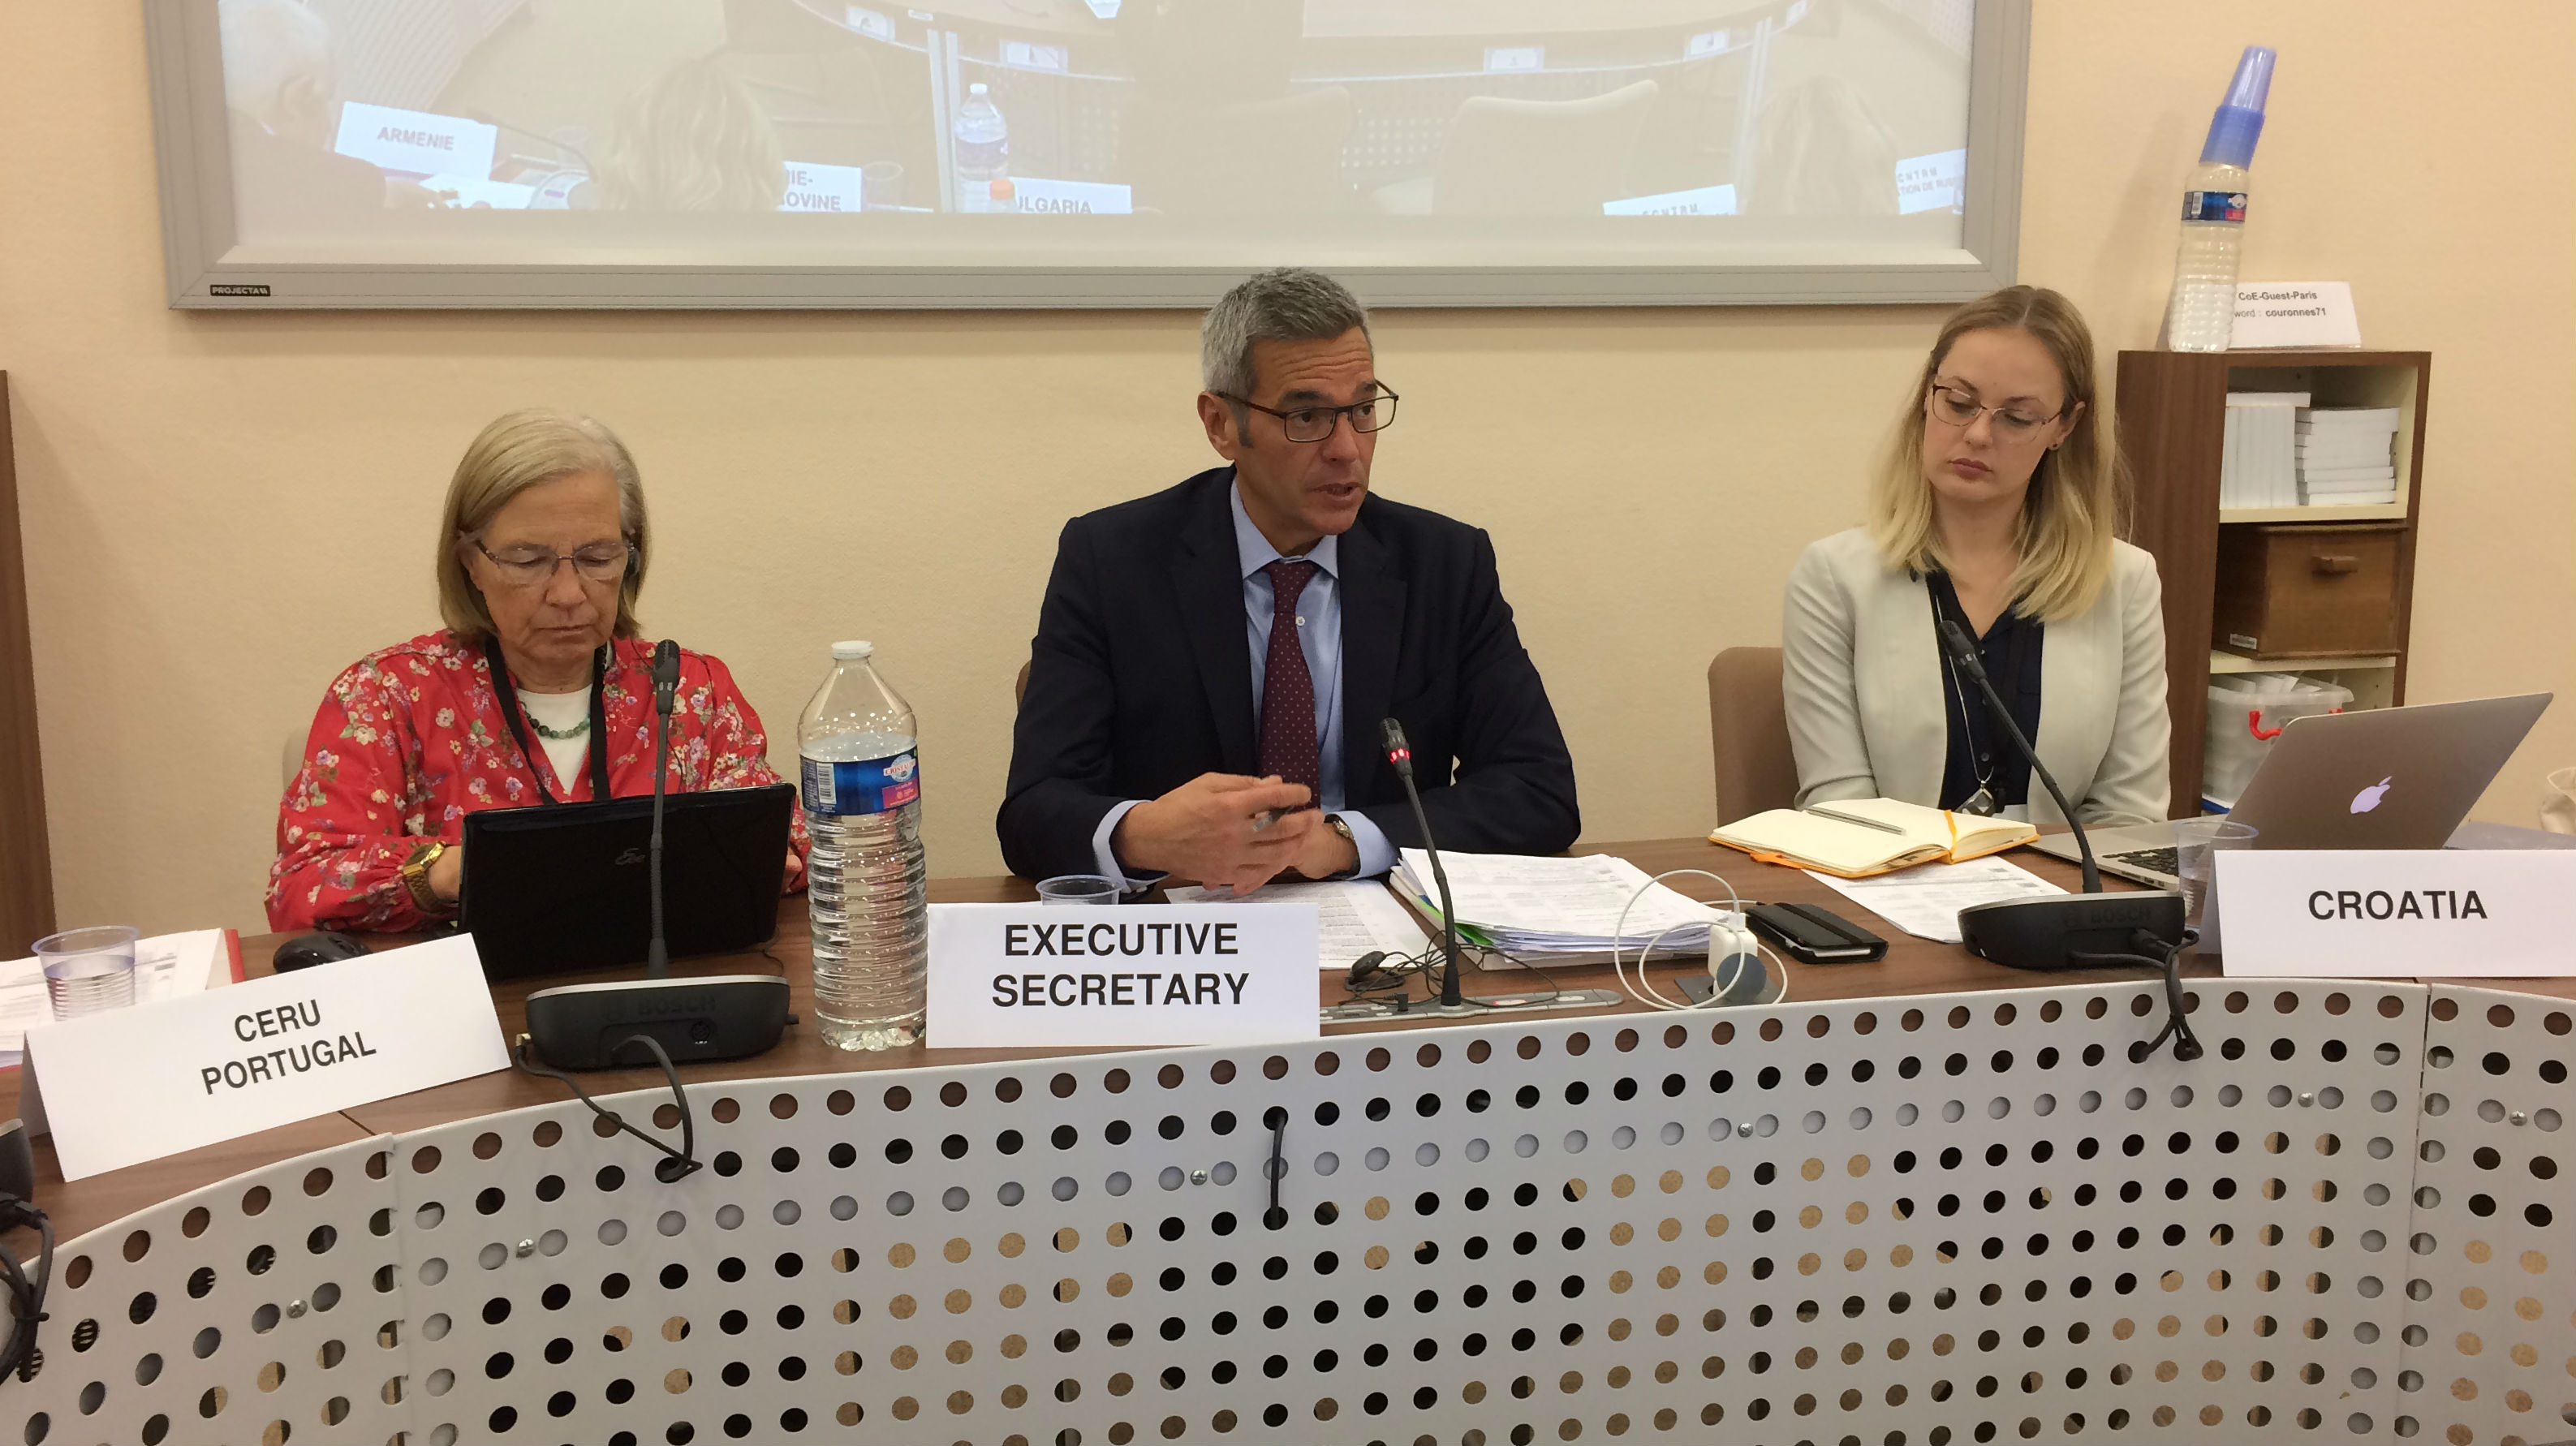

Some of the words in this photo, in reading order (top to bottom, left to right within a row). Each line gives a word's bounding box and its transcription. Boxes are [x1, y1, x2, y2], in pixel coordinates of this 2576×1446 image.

[377, 127, 454, 150] ARMENIE
[782, 192, 842, 213] OVINE
[2238, 290, 2318, 301] CoE-Guest-Paris
[2265, 307, 2326, 317] couronnes71
[2091, 906, 2151, 924] BOSCH
[2308, 890, 2488, 920] CROATIA
[1005, 923, 1238, 957] EXECUTIVE
[992, 972, 1250, 1008] SECRETARY
[235, 999, 321, 1042] CERU
[201, 1031, 377, 1095] PORTUGAL
